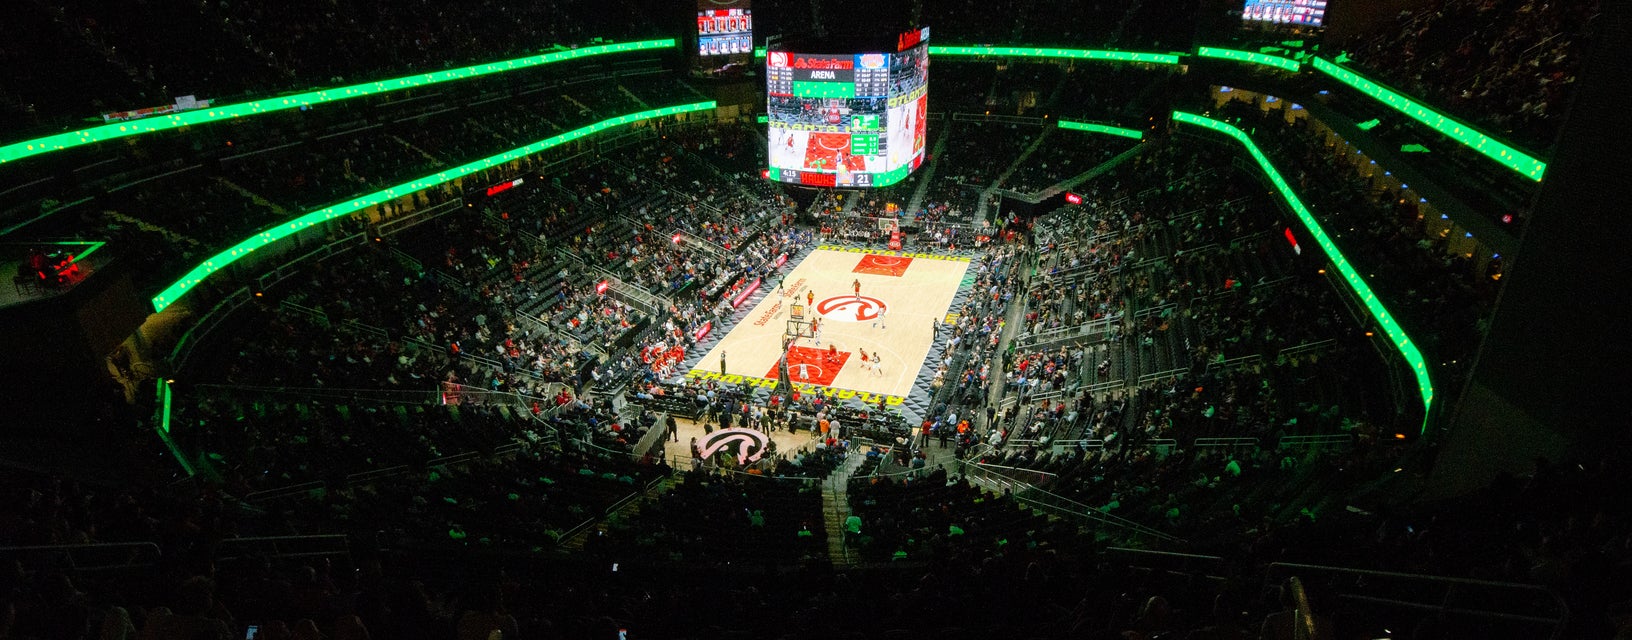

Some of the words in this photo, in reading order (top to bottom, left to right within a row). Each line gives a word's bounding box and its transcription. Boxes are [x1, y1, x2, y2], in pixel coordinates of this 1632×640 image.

[811, 71, 836, 79] ARENA
[782, 170, 796, 178] 4:15
[857, 174, 869, 183] 21
[800, 172, 836, 187] HAWKS
[817, 245, 896, 256] ATLANTA
[902, 251, 971, 263] HAWKS
